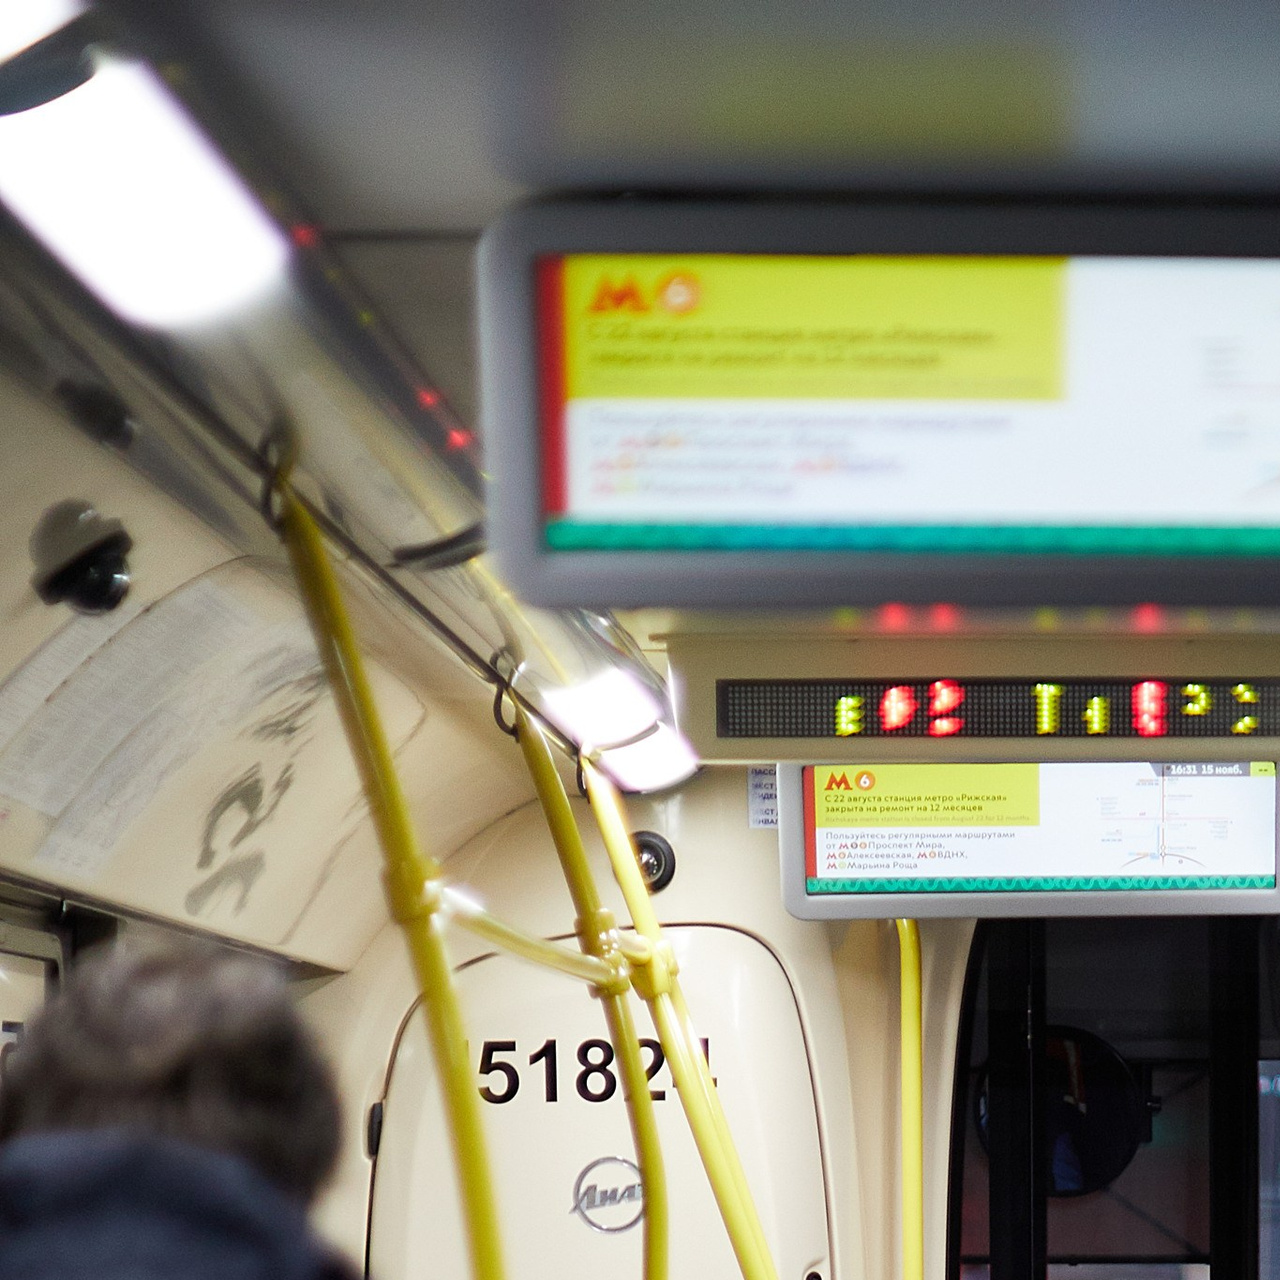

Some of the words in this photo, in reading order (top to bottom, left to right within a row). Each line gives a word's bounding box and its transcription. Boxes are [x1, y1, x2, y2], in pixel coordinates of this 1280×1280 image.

[1171, 764, 1197, 775] 16:31
[1201, 764, 1213, 775] 15
[1215, 764, 1243, 775] нояб.
[833, 795, 845, 803] 22
[847, 796, 882, 805] августа
[884, 796, 922, 804] станция
[924, 795, 954, 803] метро
[955, 794, 1007, 802] «Рижская»
[825, 805, 864, 813] закрыта
[879, 805, 914, 813] ремонт
[930, 804, 940, 812] 12
[942, 804, 983, 812] месяцев
[825, 831, 886, 840] Пользуйтесь
[888, 832, 953, 841] регулярными
[955, 831, 1015, 840] маршрутами
[868, 842, 913, 850] Проспект
[915, 841, 945, 850] Мира,
[846, 851, 915, 860] Алексеевская,
[937, 851, 968, 860] ВДНХ,
[846, 861, 890, 870] Марьина
[892, 861, 918, 870] Роща
[466, 1037, 718, 1105] 5182
